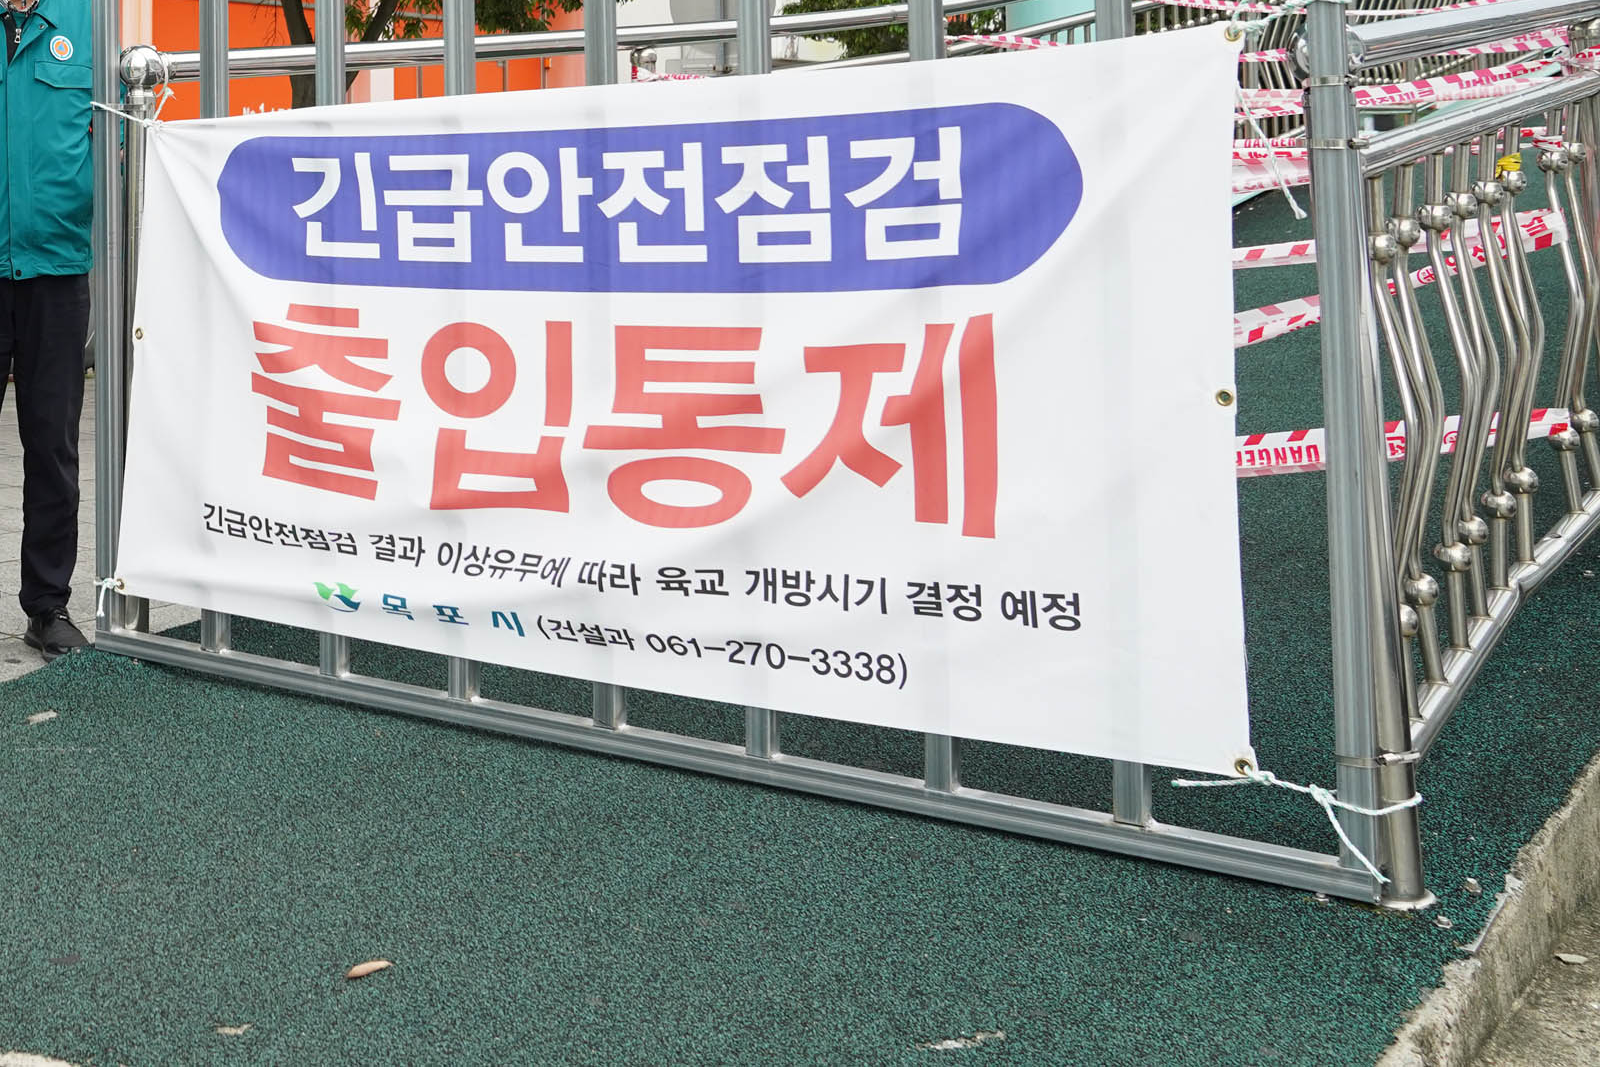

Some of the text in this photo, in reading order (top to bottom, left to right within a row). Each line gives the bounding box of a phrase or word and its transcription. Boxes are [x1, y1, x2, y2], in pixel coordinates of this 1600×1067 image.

[292, 125, 963, 264] 긴급안전점검
[251, 304, 997, 539] 출입통제
[203, 502, 1082, 632] 긴급안전점검 결과 이상유무에 따라 육교 개방시기 결정 예정
[537, 615, 636, 651] (건설과
[646, 633, 909, 690] 061-270-3338)
